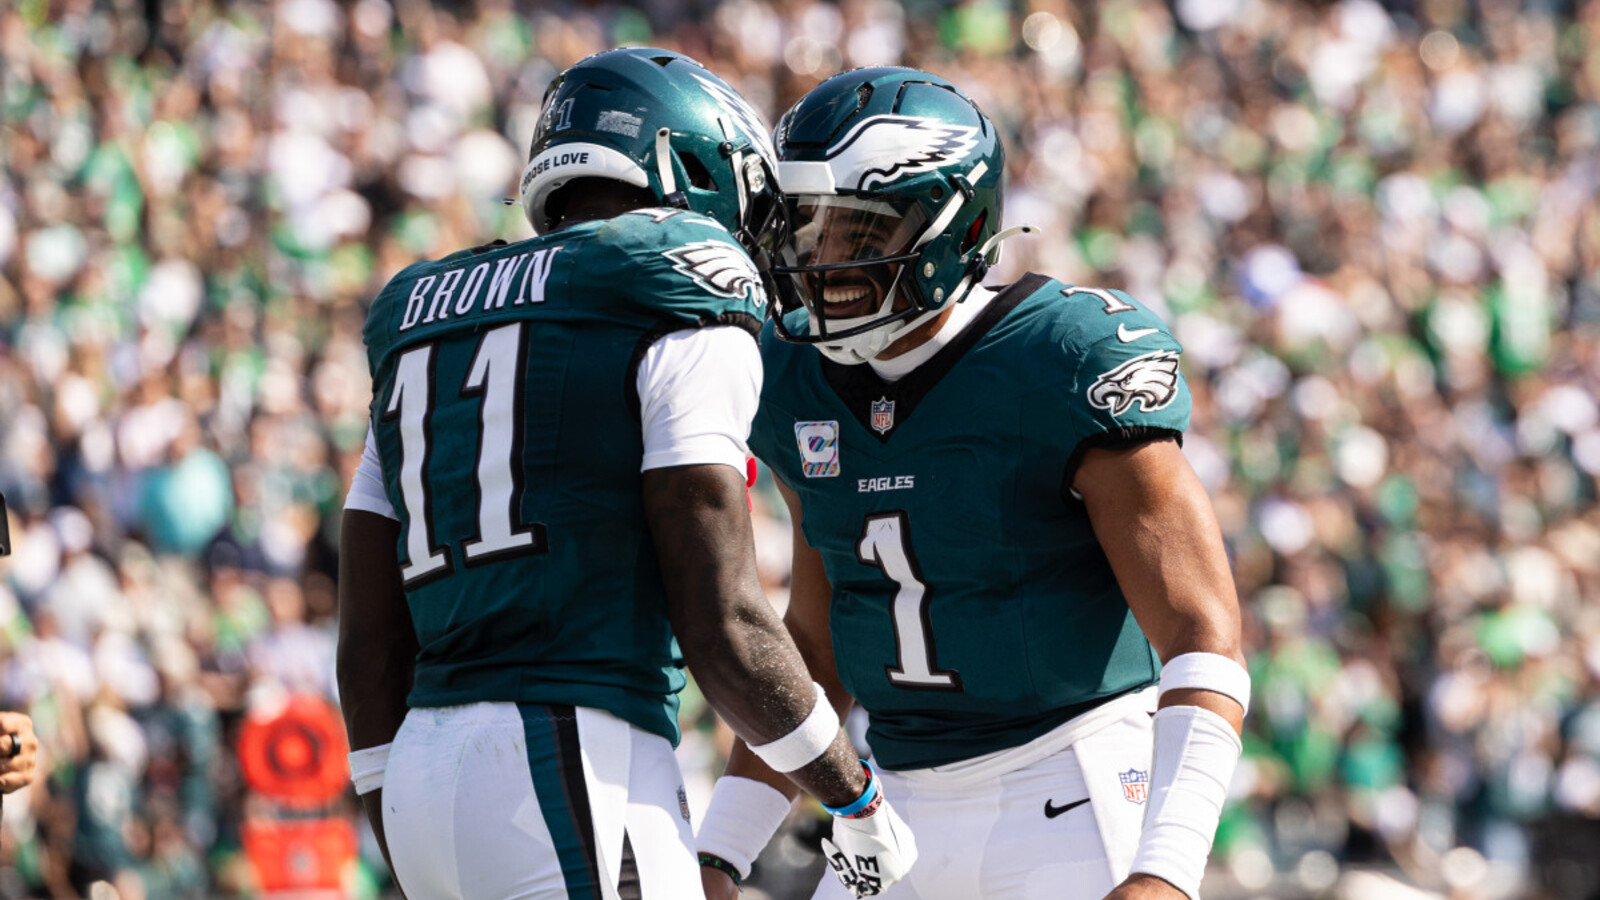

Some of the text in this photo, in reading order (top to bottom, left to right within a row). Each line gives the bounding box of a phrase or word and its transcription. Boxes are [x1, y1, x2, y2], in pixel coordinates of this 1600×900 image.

[553, 153, 589, 167] LOVE
[399, 246, 564, 332] BROWN
[1060, 286, 1137, 315] 1
[873, 412, 891, 428] NFL
[383, 319, 549, 592] 11
[799, 425, 835, 463] C
[857, 475, 916, 492] EAGLES
[858, 511, 963, 691] 1
